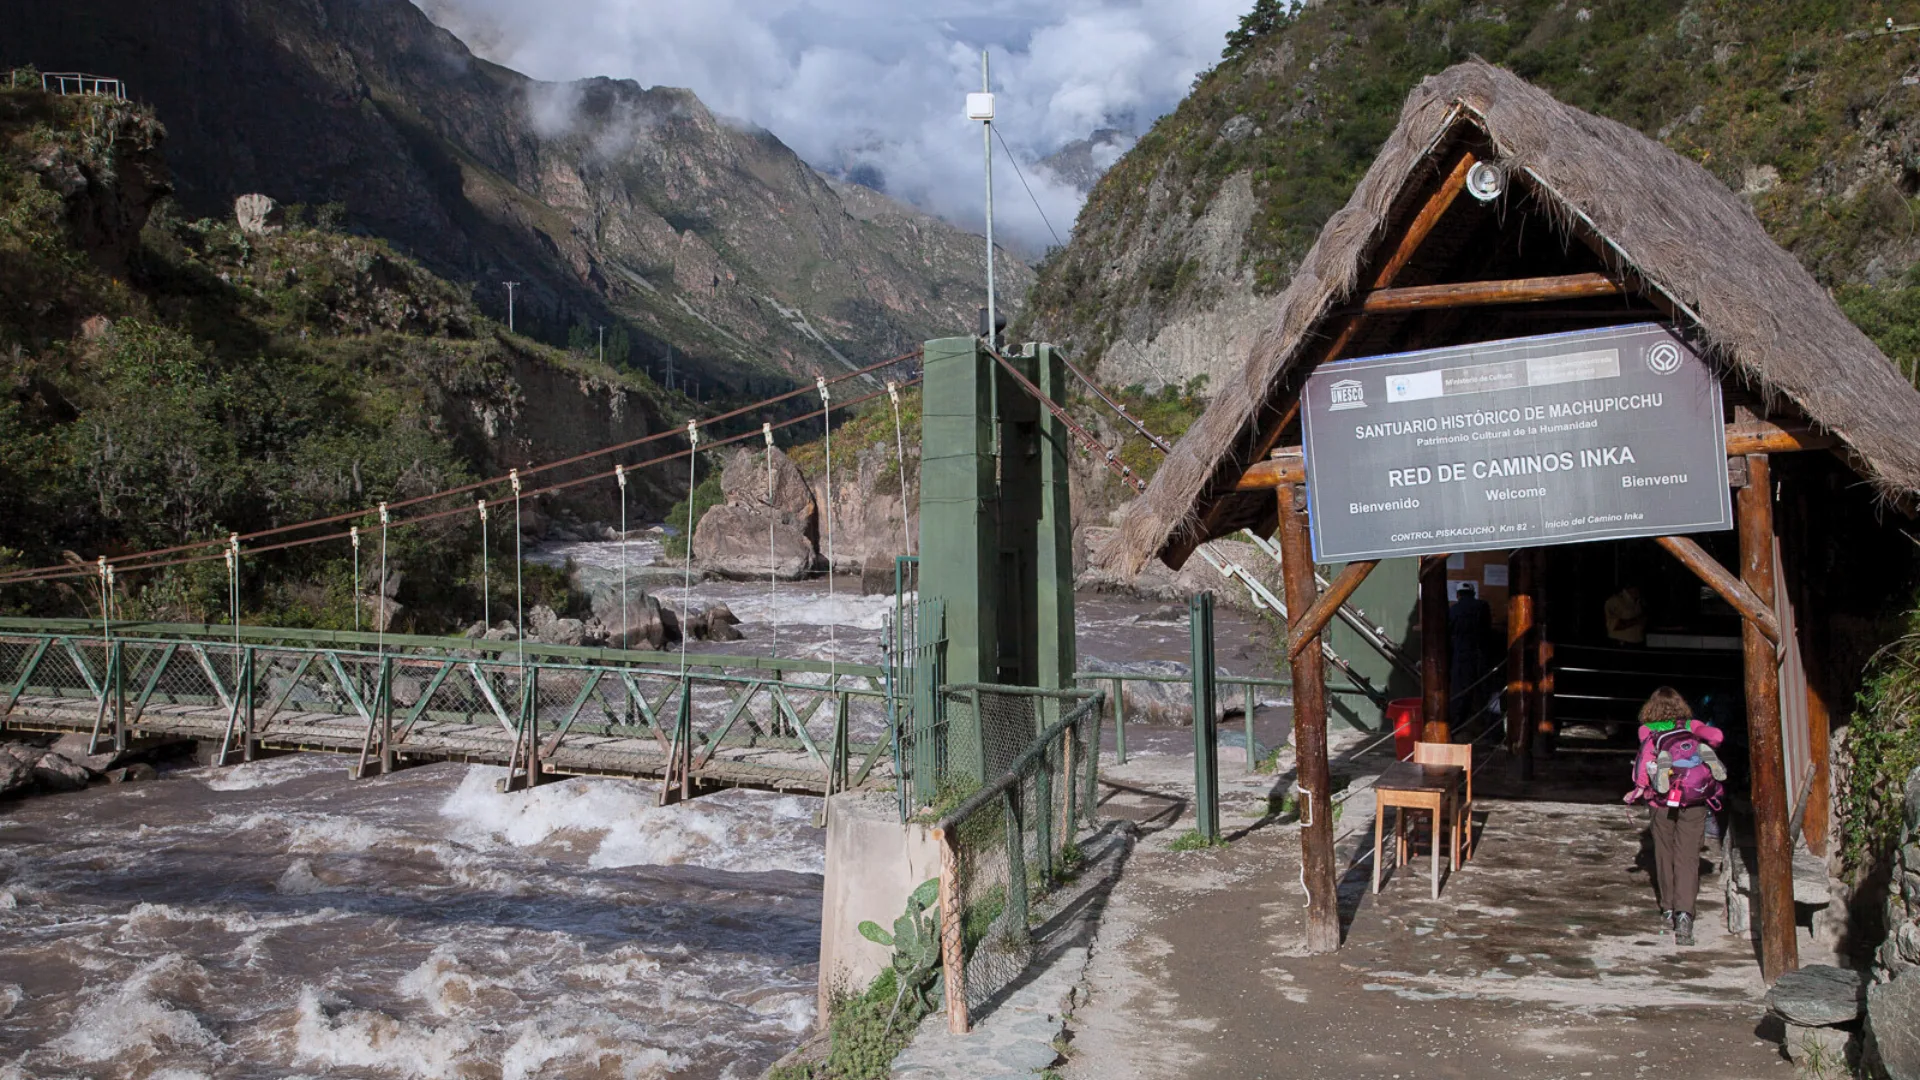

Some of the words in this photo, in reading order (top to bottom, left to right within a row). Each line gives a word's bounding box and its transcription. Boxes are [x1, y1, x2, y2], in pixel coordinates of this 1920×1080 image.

[1331, 387, 1364, 403] UNESCO
[1356, 418, 1437, 440] SANTUARIO
[1441, 409, 1520, 430] HISTÓRICO
[1525, 405, 1545, 421] DE
[1549, 393, 1663, 418] MACHUPICCHU
[1417, 434, 1470, 447] Patrimonio
[1472, 429, 1511, 441] Cultural
[1513, 426, 1525, 436] de
[1528, 426, 1537, 435] la
[1540, 419, 1598, 434] Humanidad
[1388, 466, 1432, 488] RED
[1437, 463, 1467, 483] DE
[1472, 451, 1574, 479] CAMINOS
[1580, 446, 1636, 468] INKA
[1350, 497, 1420, 514] Bienvenido
[1485, 487, 1546, 501] Welcome
[1622, 472, 1688, 488] Bienvenu
[1391, 530, 1434, 542] CONTROL
[1435, 525, 1495, 538] PISKACUCHO
[1500, 524, 1514, 532] Km
[1516, 523, 1527, 531] 82
[1545, 520, 1569, 529] Inicio
[1571, 517, 1585, 526] del
[1587, 514, 1622, 524] Camino
[1624, 512, 1644, 520] Inka
